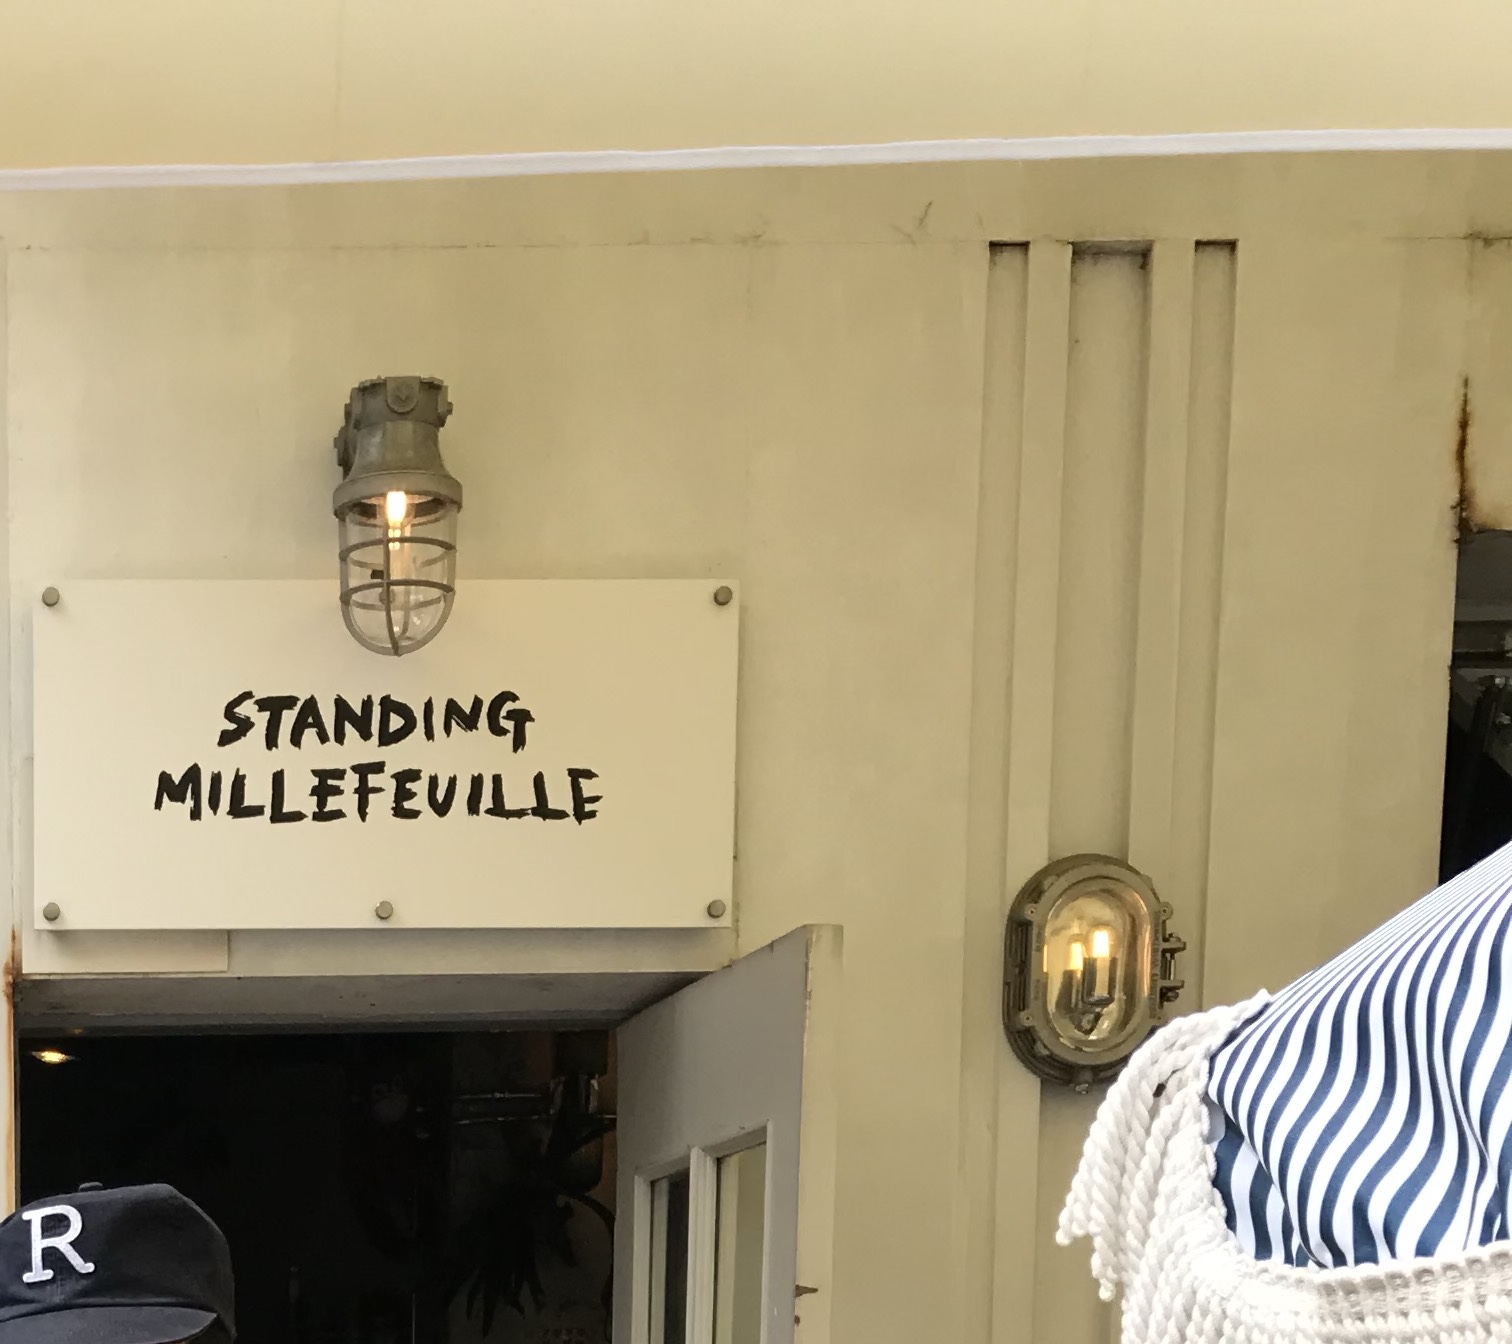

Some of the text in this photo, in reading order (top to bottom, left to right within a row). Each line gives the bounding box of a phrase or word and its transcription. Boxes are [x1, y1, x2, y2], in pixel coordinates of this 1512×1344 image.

[217, 691, 535, 753] STANDING
[154, 761, 604, 825] MILLEFEUILLE
[22, 1205, 95, 1283] R
